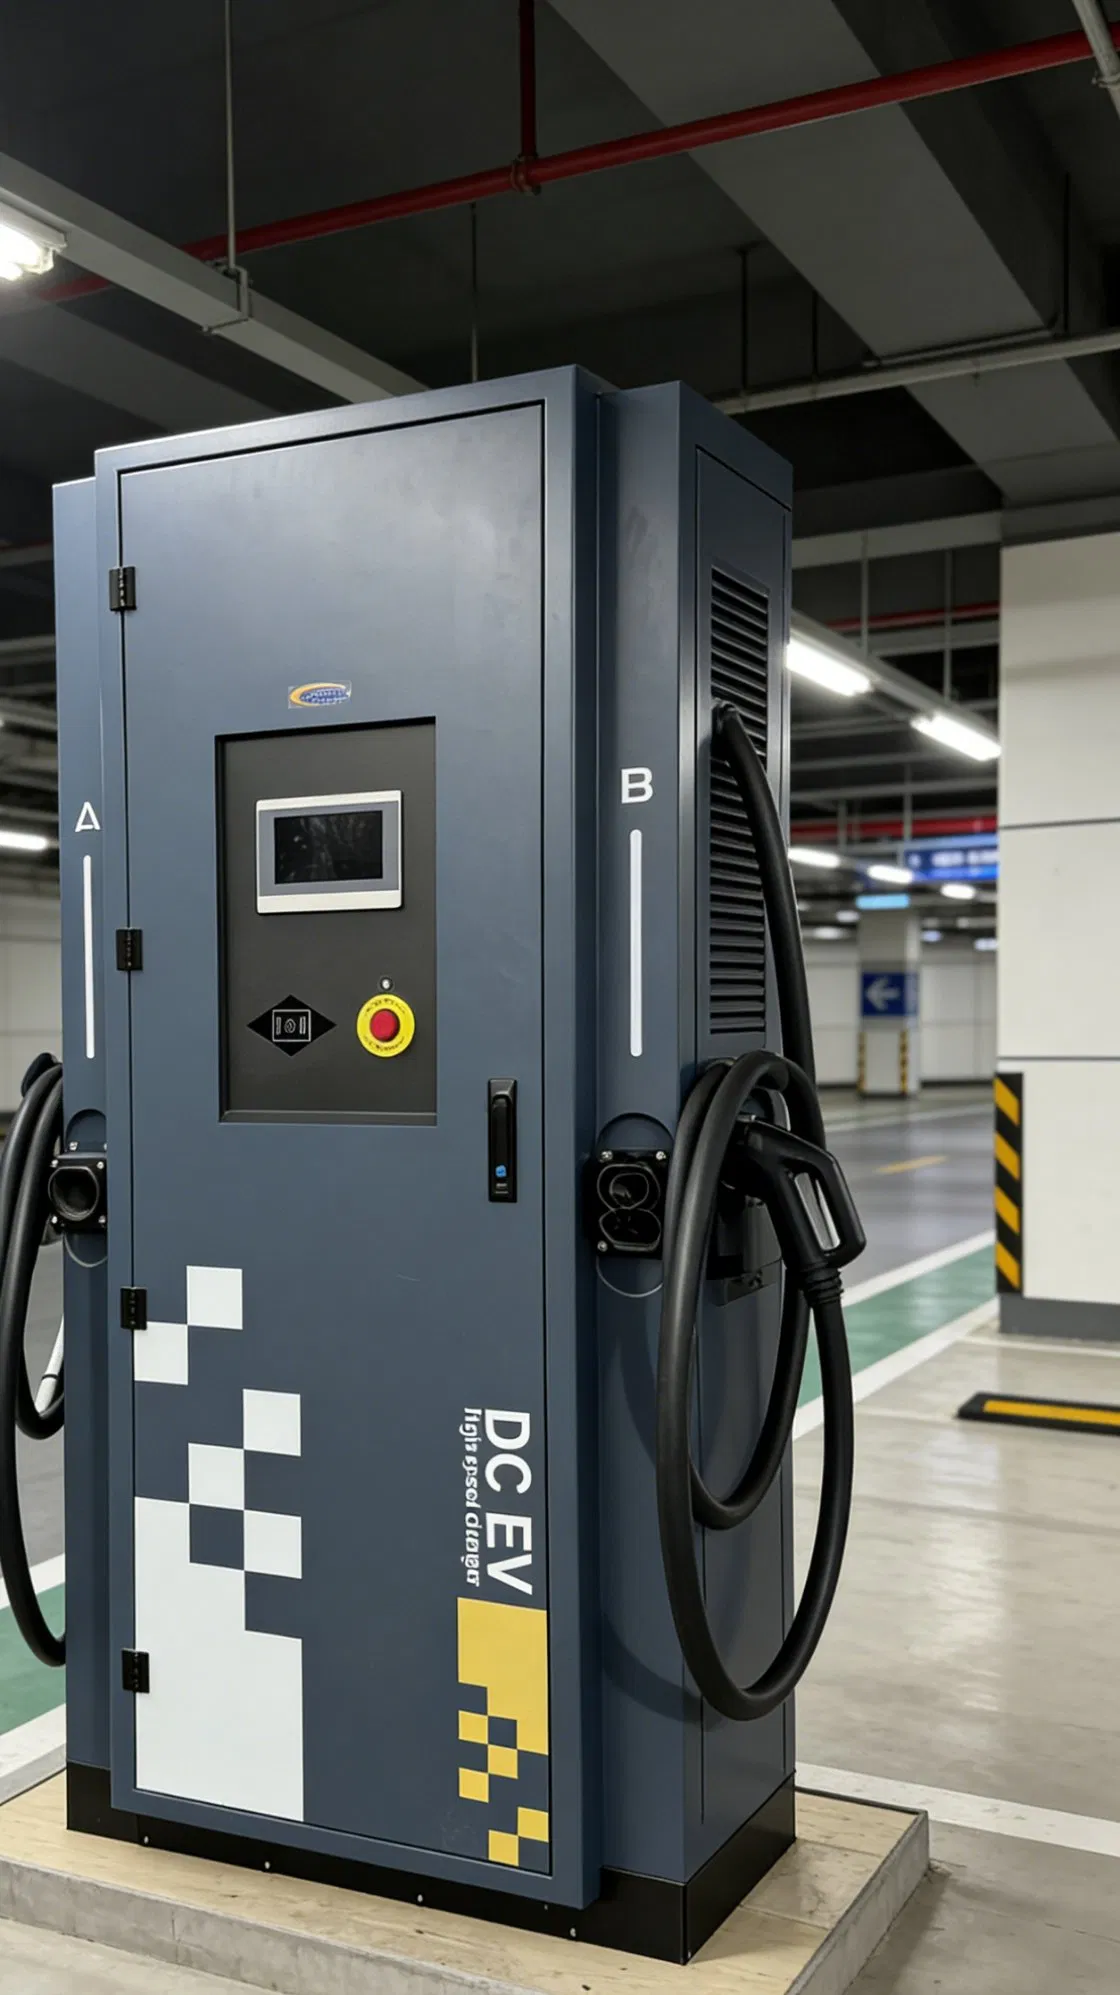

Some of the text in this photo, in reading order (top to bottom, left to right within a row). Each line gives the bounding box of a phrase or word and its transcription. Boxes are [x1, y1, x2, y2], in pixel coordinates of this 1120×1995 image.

[621, 767, 654, 804] B
[75, 801, 101, 833] A
[484, 1408, 534, 1596] DC EV
